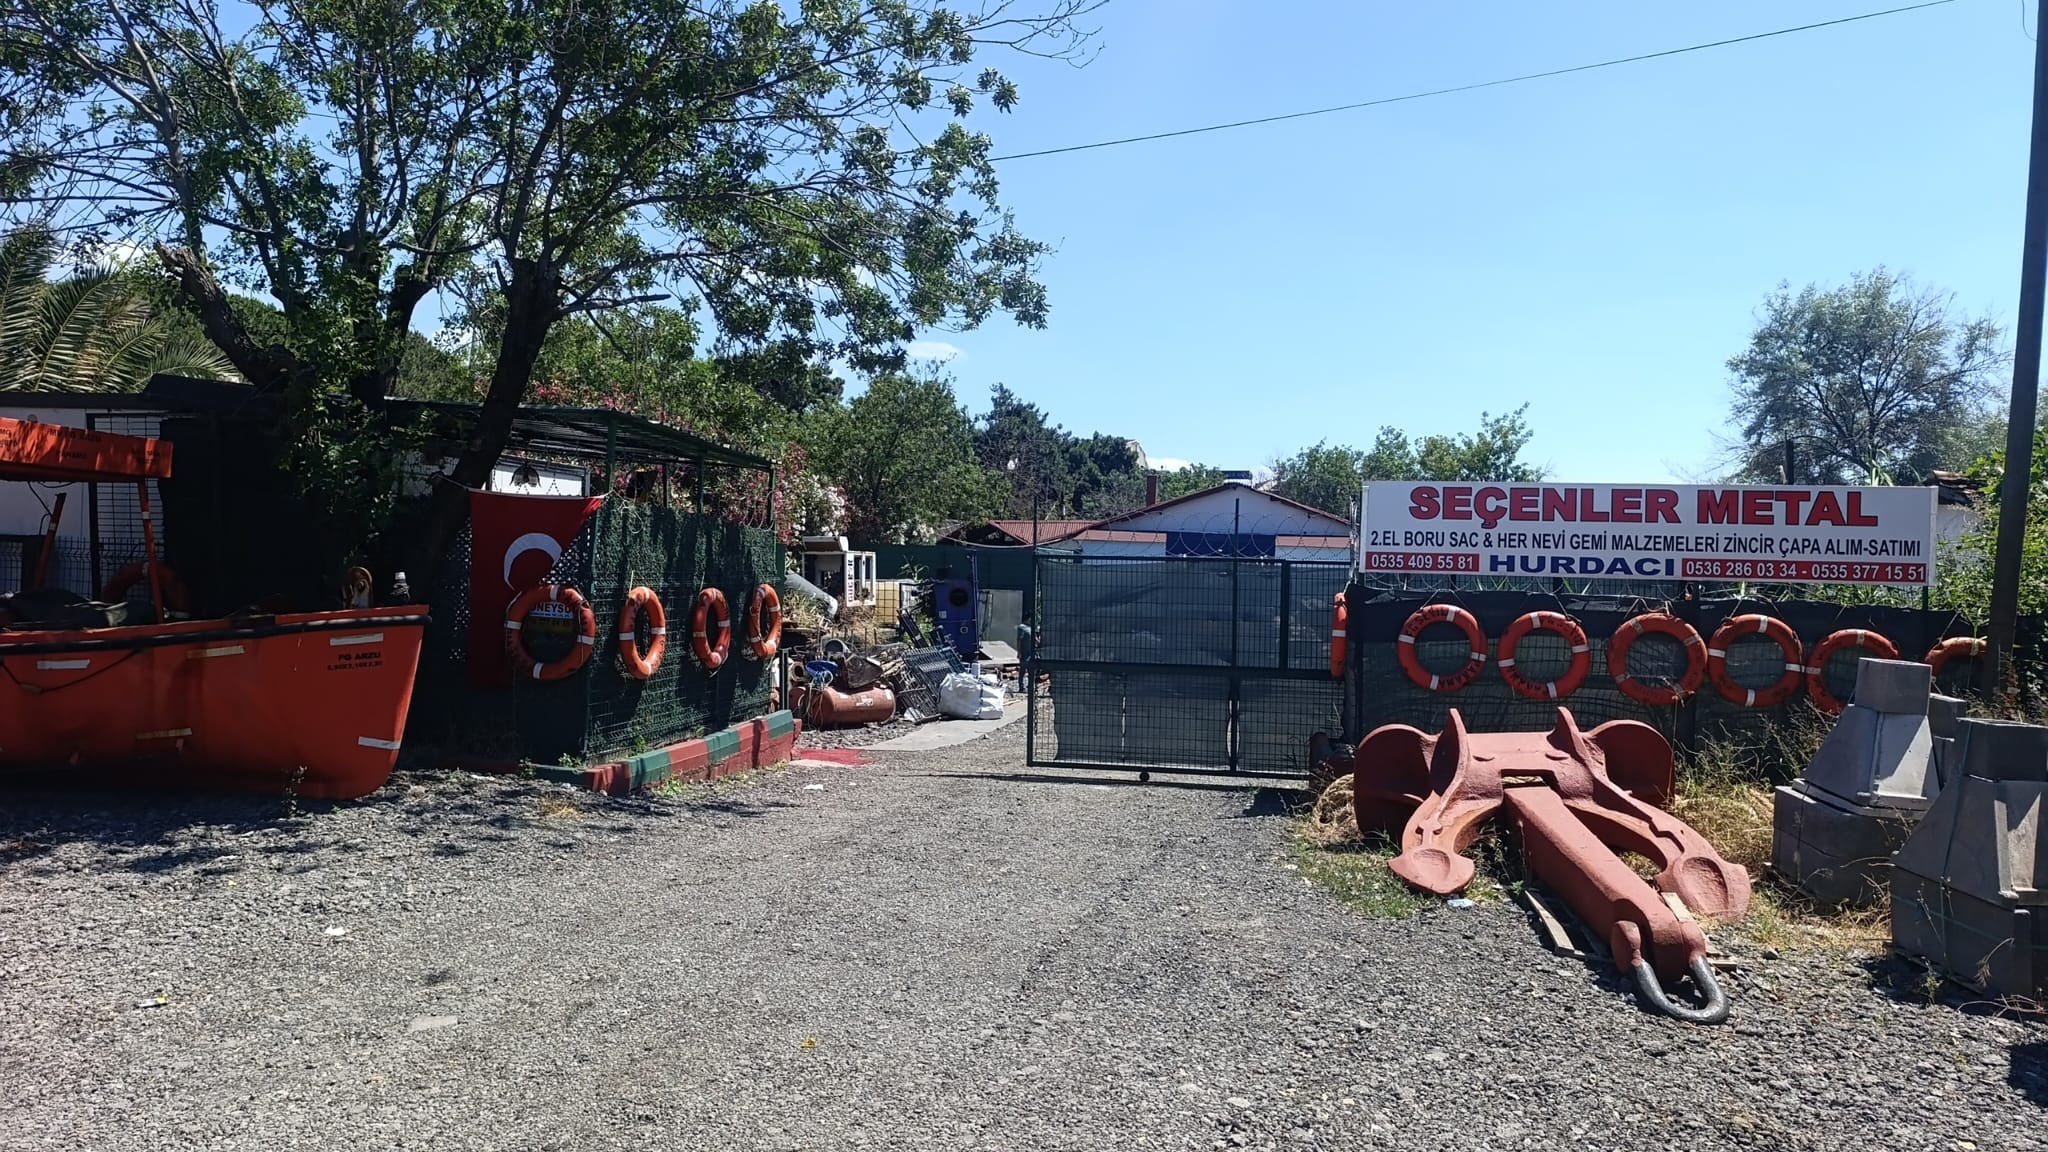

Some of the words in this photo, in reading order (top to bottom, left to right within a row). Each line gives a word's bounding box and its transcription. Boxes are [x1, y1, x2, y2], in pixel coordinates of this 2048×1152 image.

[1408, 486, 1682, 529] SEÇENLER
[1697, 489, 1879, 527] METAL
[1370, 530, 1400, 546] 2.EL
[1404, 531, 1445, 547] BORU
[1450, 531, 1479, 548] SAC
[1483, 532, 1493, 548] &
[1499, 532, 1528, 549] HER
[1532, 530, 1566, 549] NEVİ
[1570, 531, 1607, 550] GEMİ
[1611, 532, 1719, 553] MALZEMELERİ
[1724, 533, 1774, 554] ZİNCİR
[1779, 537, 1822, 558] ÇAPA
[1825, 538, 1921, 557] ALIM-SATIMI
[1371, 554, 1404, 568] 0535
[1408, 554, 1433, 569] 409
[1437, 555, 1454, 569] 55
[1458, 555, 1473, 570] 81
[1489, 555, 1675, 576] HURDACI
[1686, 560, 1721, 575] 0536
[1725, 562, 1752, 576] 286
[1757, 562, 1775, 577] 03
[1779, 563, 1797, 577] 34
[1811, 564, 1848, 578] 0535
[1853, 565, 1879, 579] 377
[1885, 565, 1903, 580] 15
[1908, 566, 1926, 581] 51
